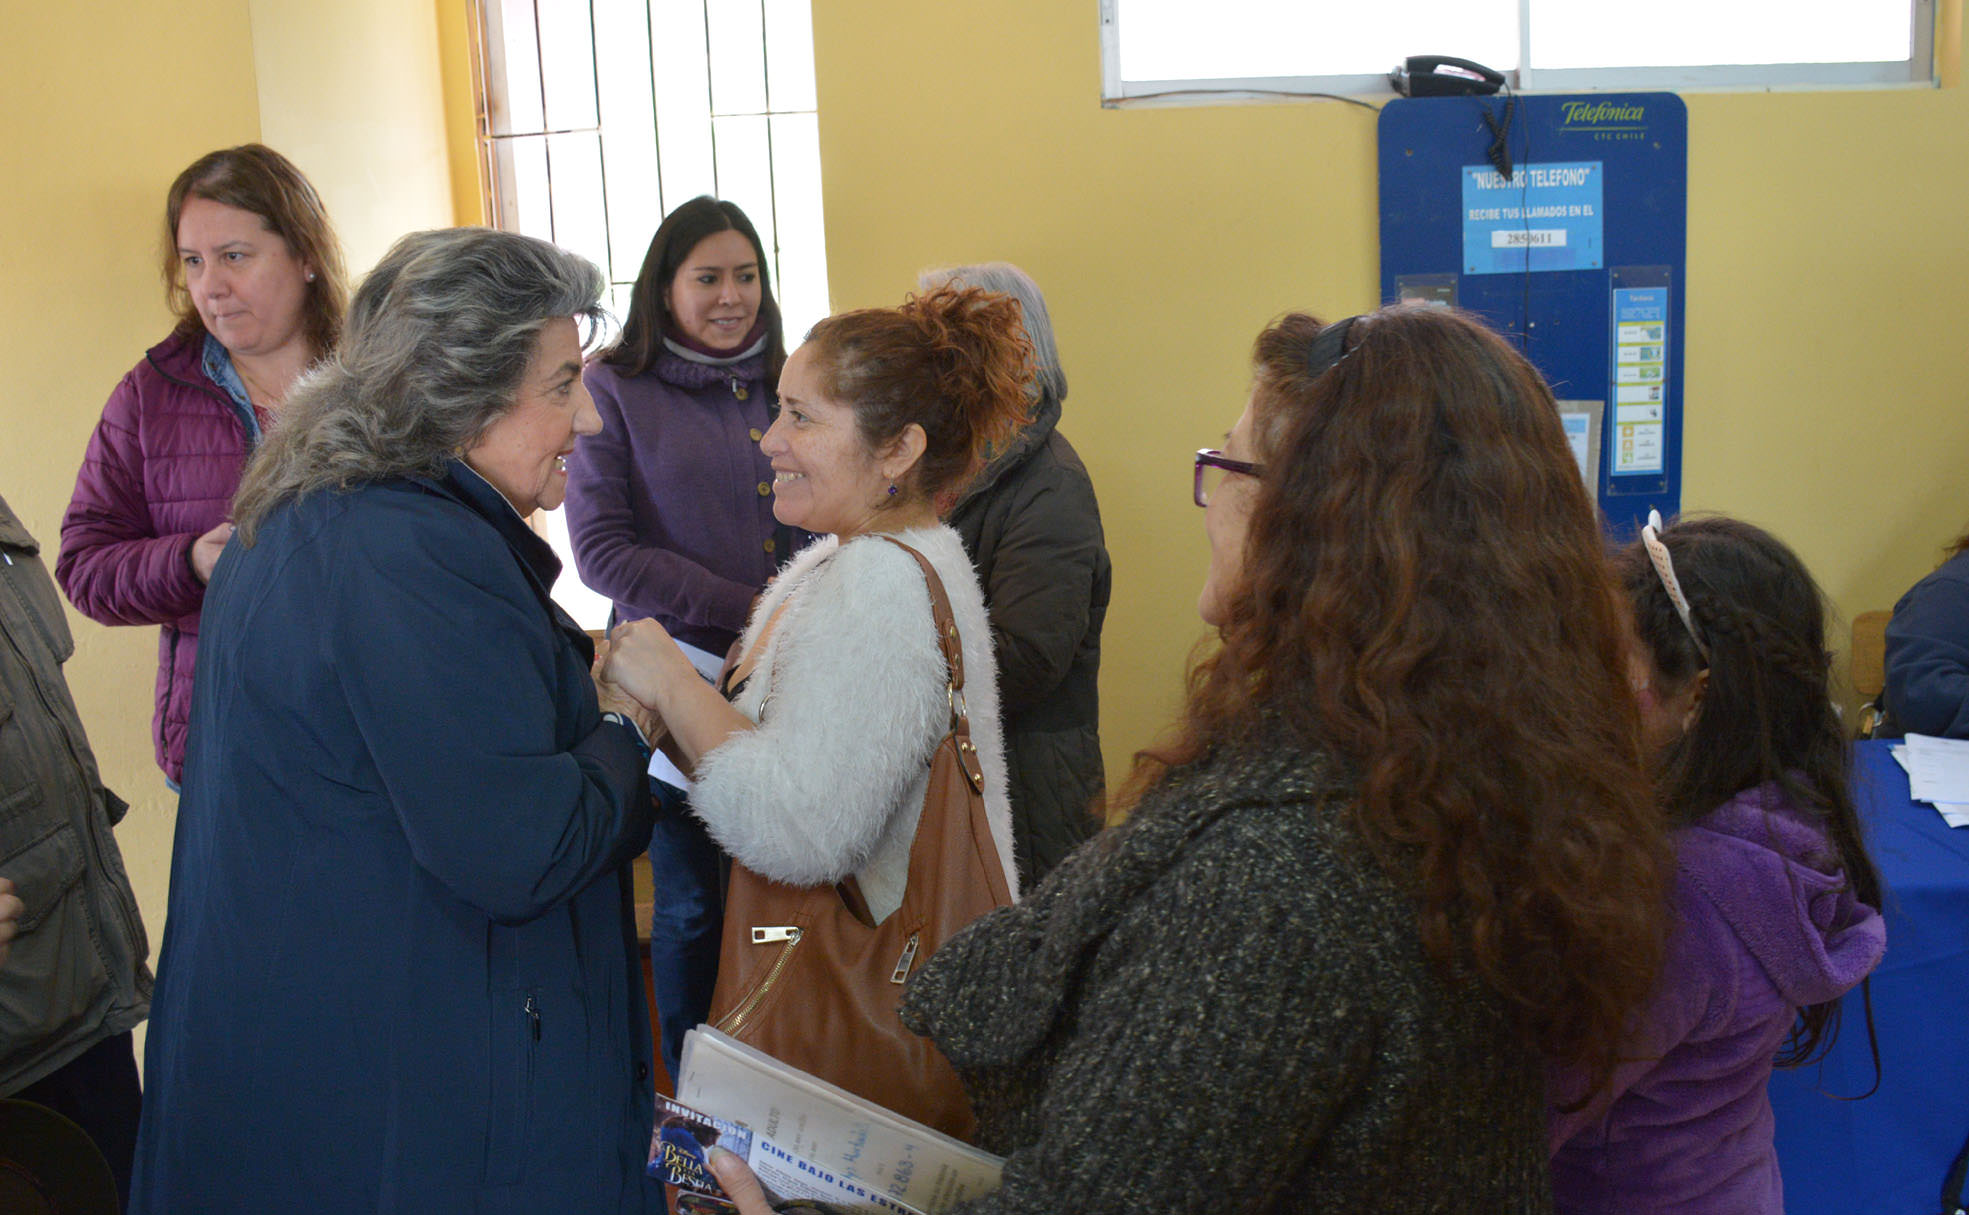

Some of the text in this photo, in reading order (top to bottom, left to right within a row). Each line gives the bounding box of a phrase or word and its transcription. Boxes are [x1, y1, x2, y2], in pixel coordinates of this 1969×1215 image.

[1616, 132, 1646, 141] CHILE
[1469, 204, 1594, 220] RECIBE TUS LLAMADOS EN EL
[761, 1141, 793, 1163] CINE
[798, 1160, 834, 1183] BAJO
[839, 1180, 866, 1198] LAS
